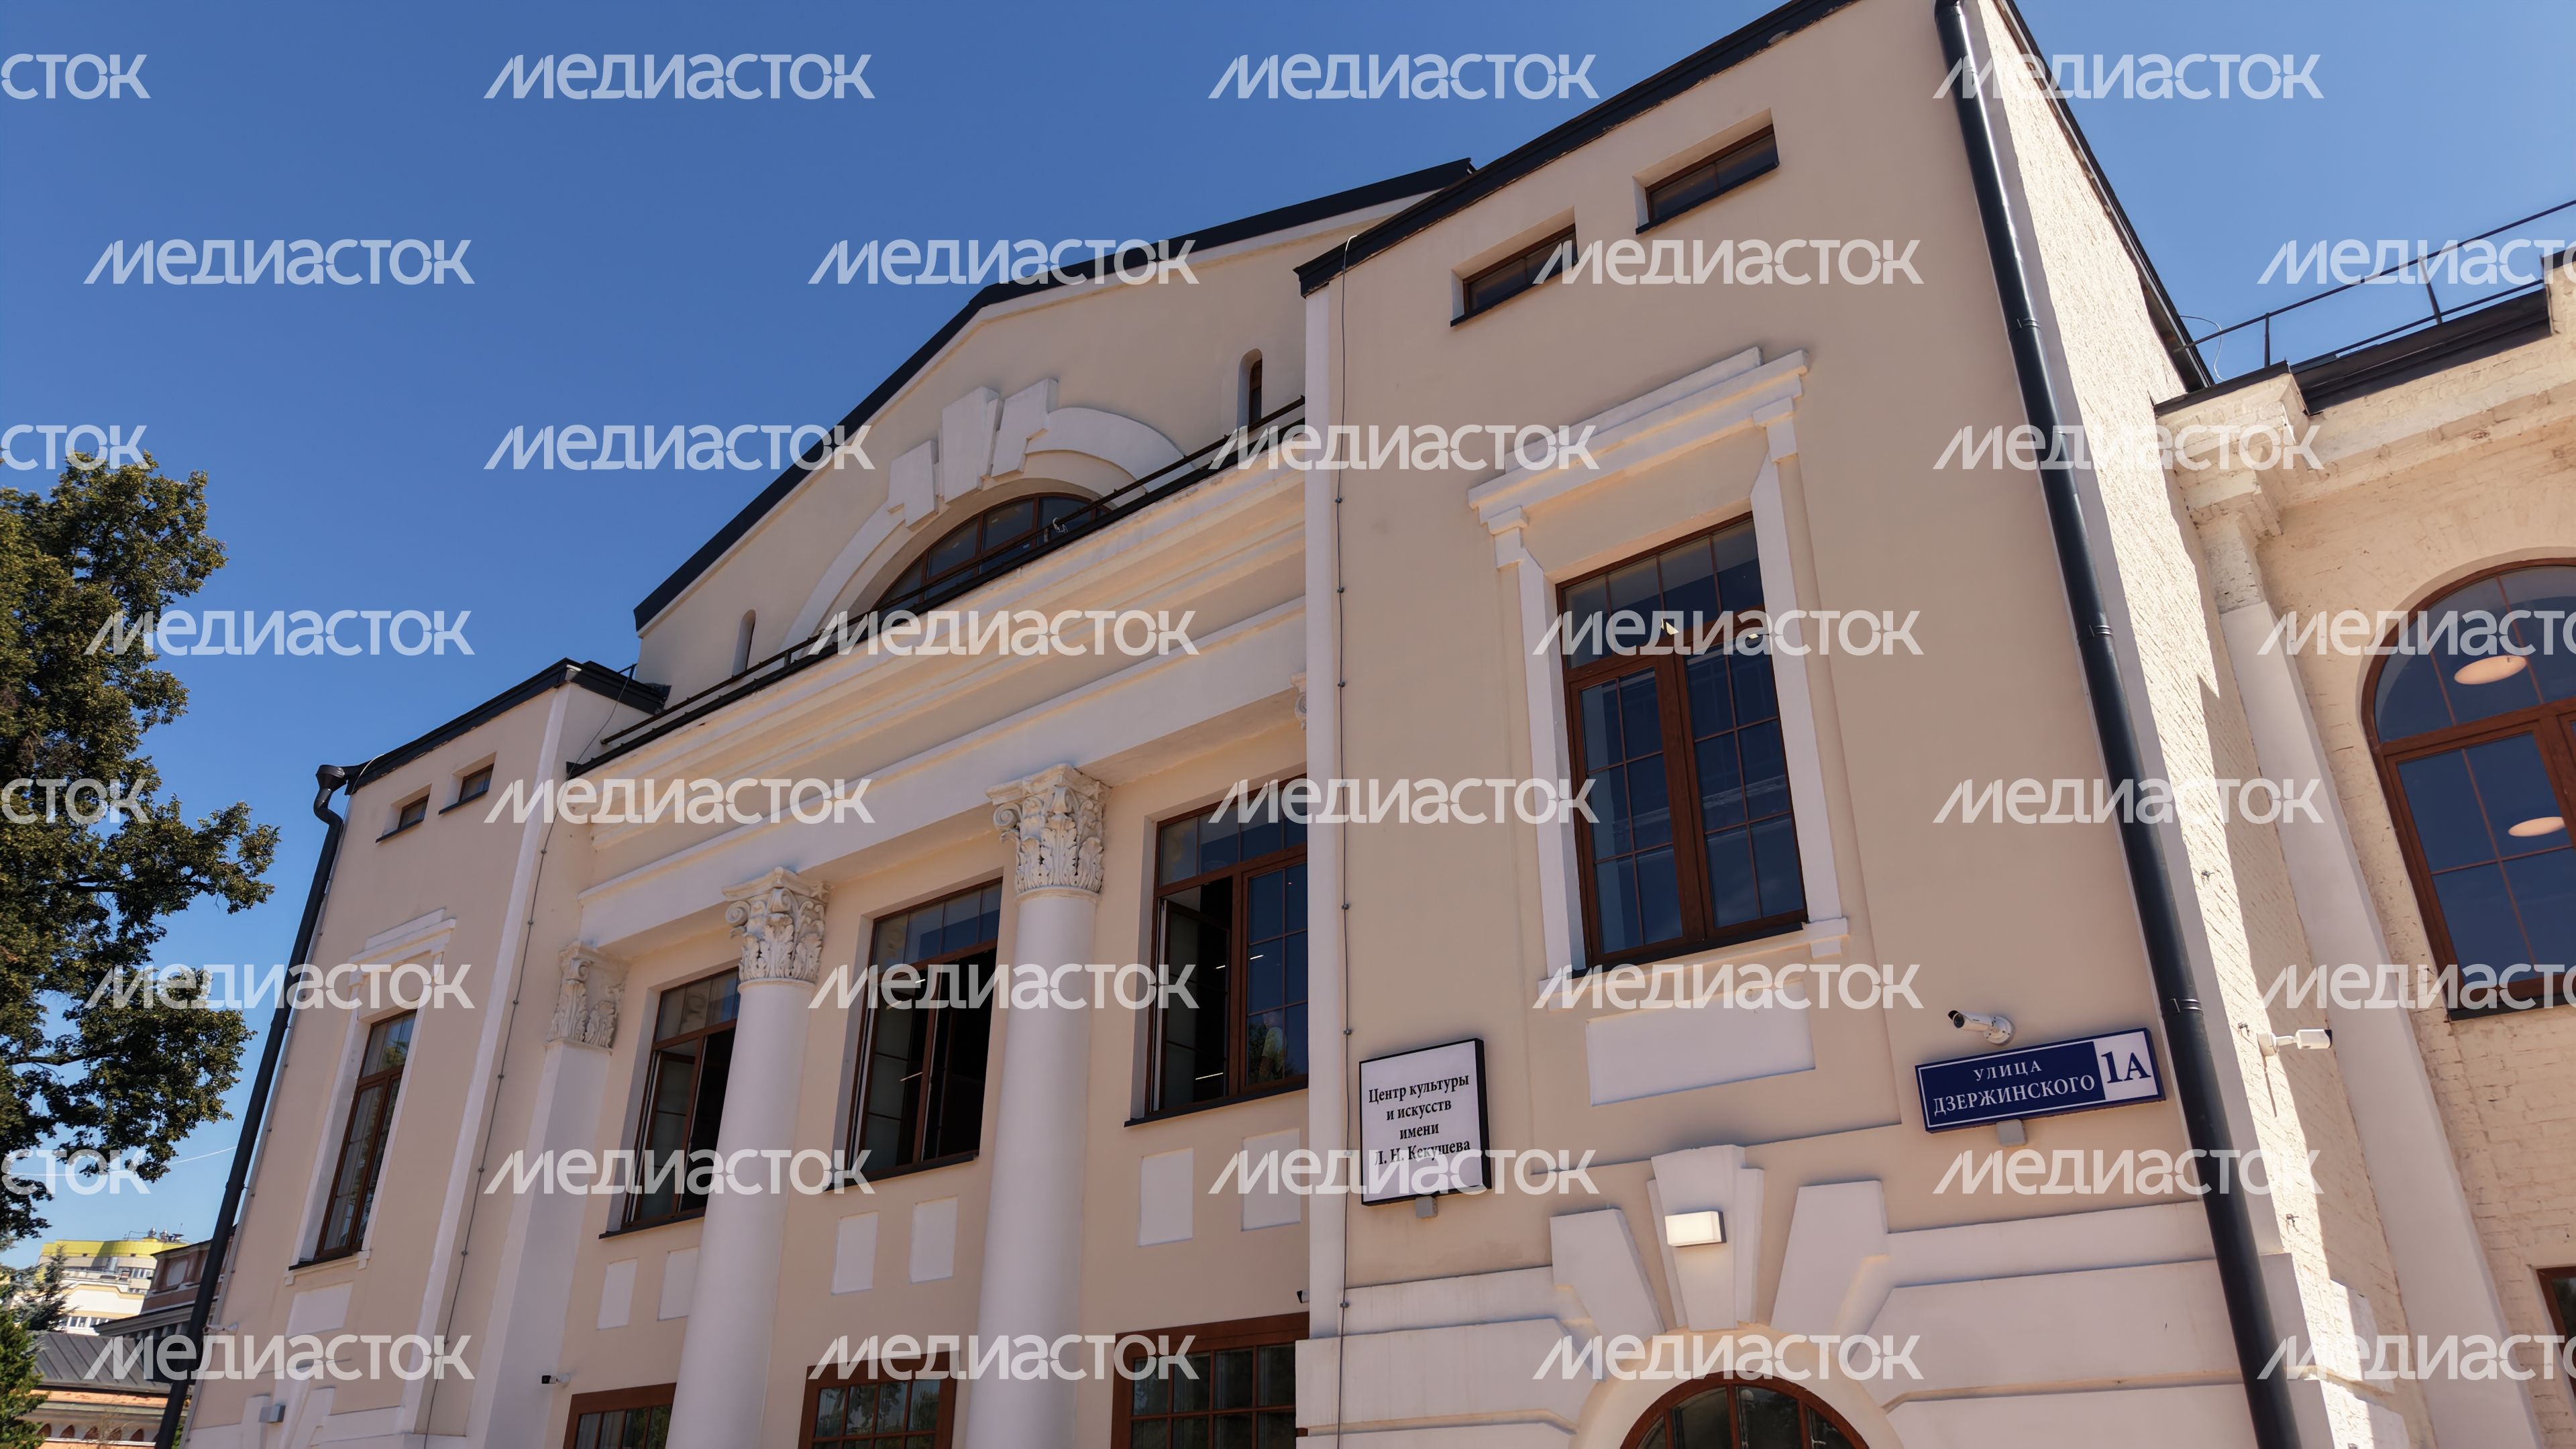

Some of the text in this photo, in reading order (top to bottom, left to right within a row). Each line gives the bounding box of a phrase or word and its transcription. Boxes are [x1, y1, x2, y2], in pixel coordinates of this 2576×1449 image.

[1973, 1060, 2042, 1082] УЛИЦА
[2100, 1051, 2152, 1083] 1А
[1368, 1075, 1469, 1105] Центр культуры
[1933, 1074, 2096, 1117] ДЗЕРЖИНСКОГО
[1386, 1100, 1452, 1120] и искусств
[1399, 1124, 1439, 1140] имени
[1375, 1140, 1471, 1166] Л. Н. Кекушева
